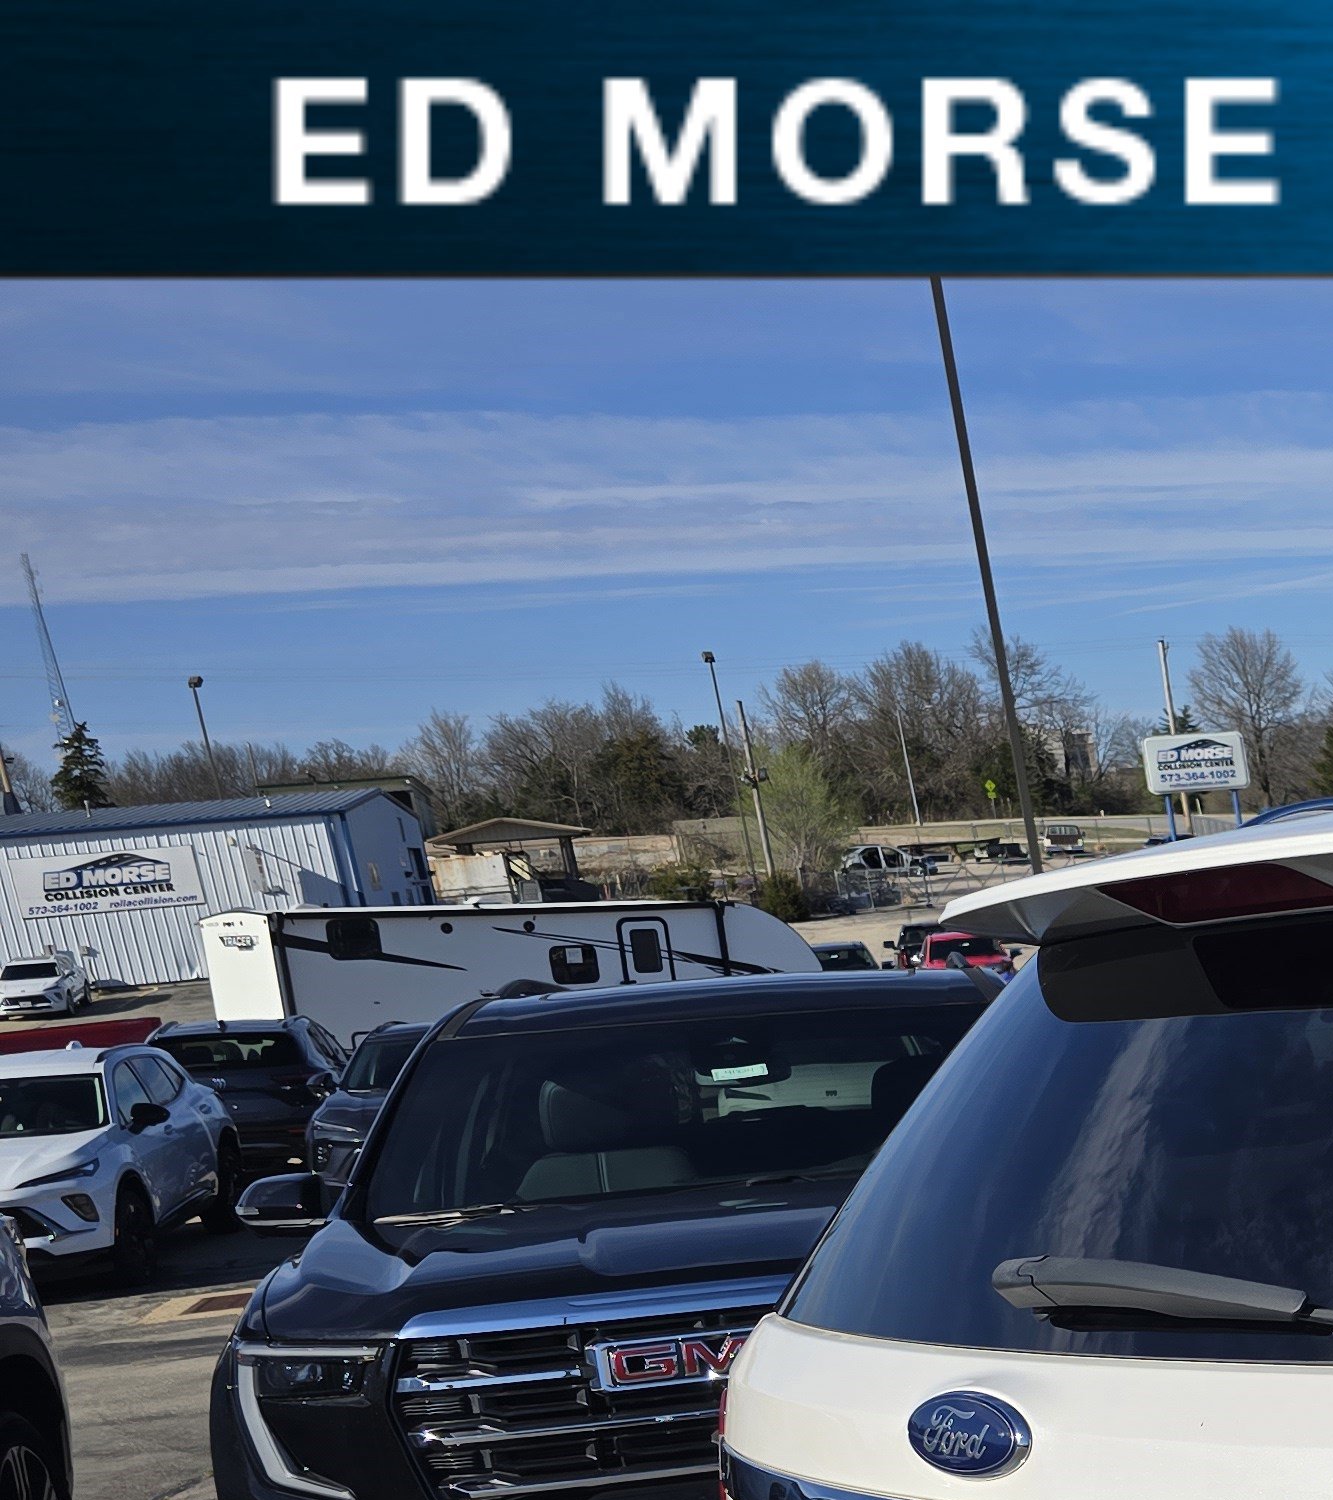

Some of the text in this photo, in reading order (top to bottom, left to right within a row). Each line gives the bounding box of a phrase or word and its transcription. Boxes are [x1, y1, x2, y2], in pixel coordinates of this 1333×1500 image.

[1158, 747, 1233, 762] ED MORSE
[43, 863, 171, 891] ED MORSE
[28, 894, 198, 916] 573-364-1002 rollacollision.com
[44, 882, 176, 903] COLLISION CENTER
[611, 1334, 748, 1385] GM
[923, 1404, 990, 1460] Ford
